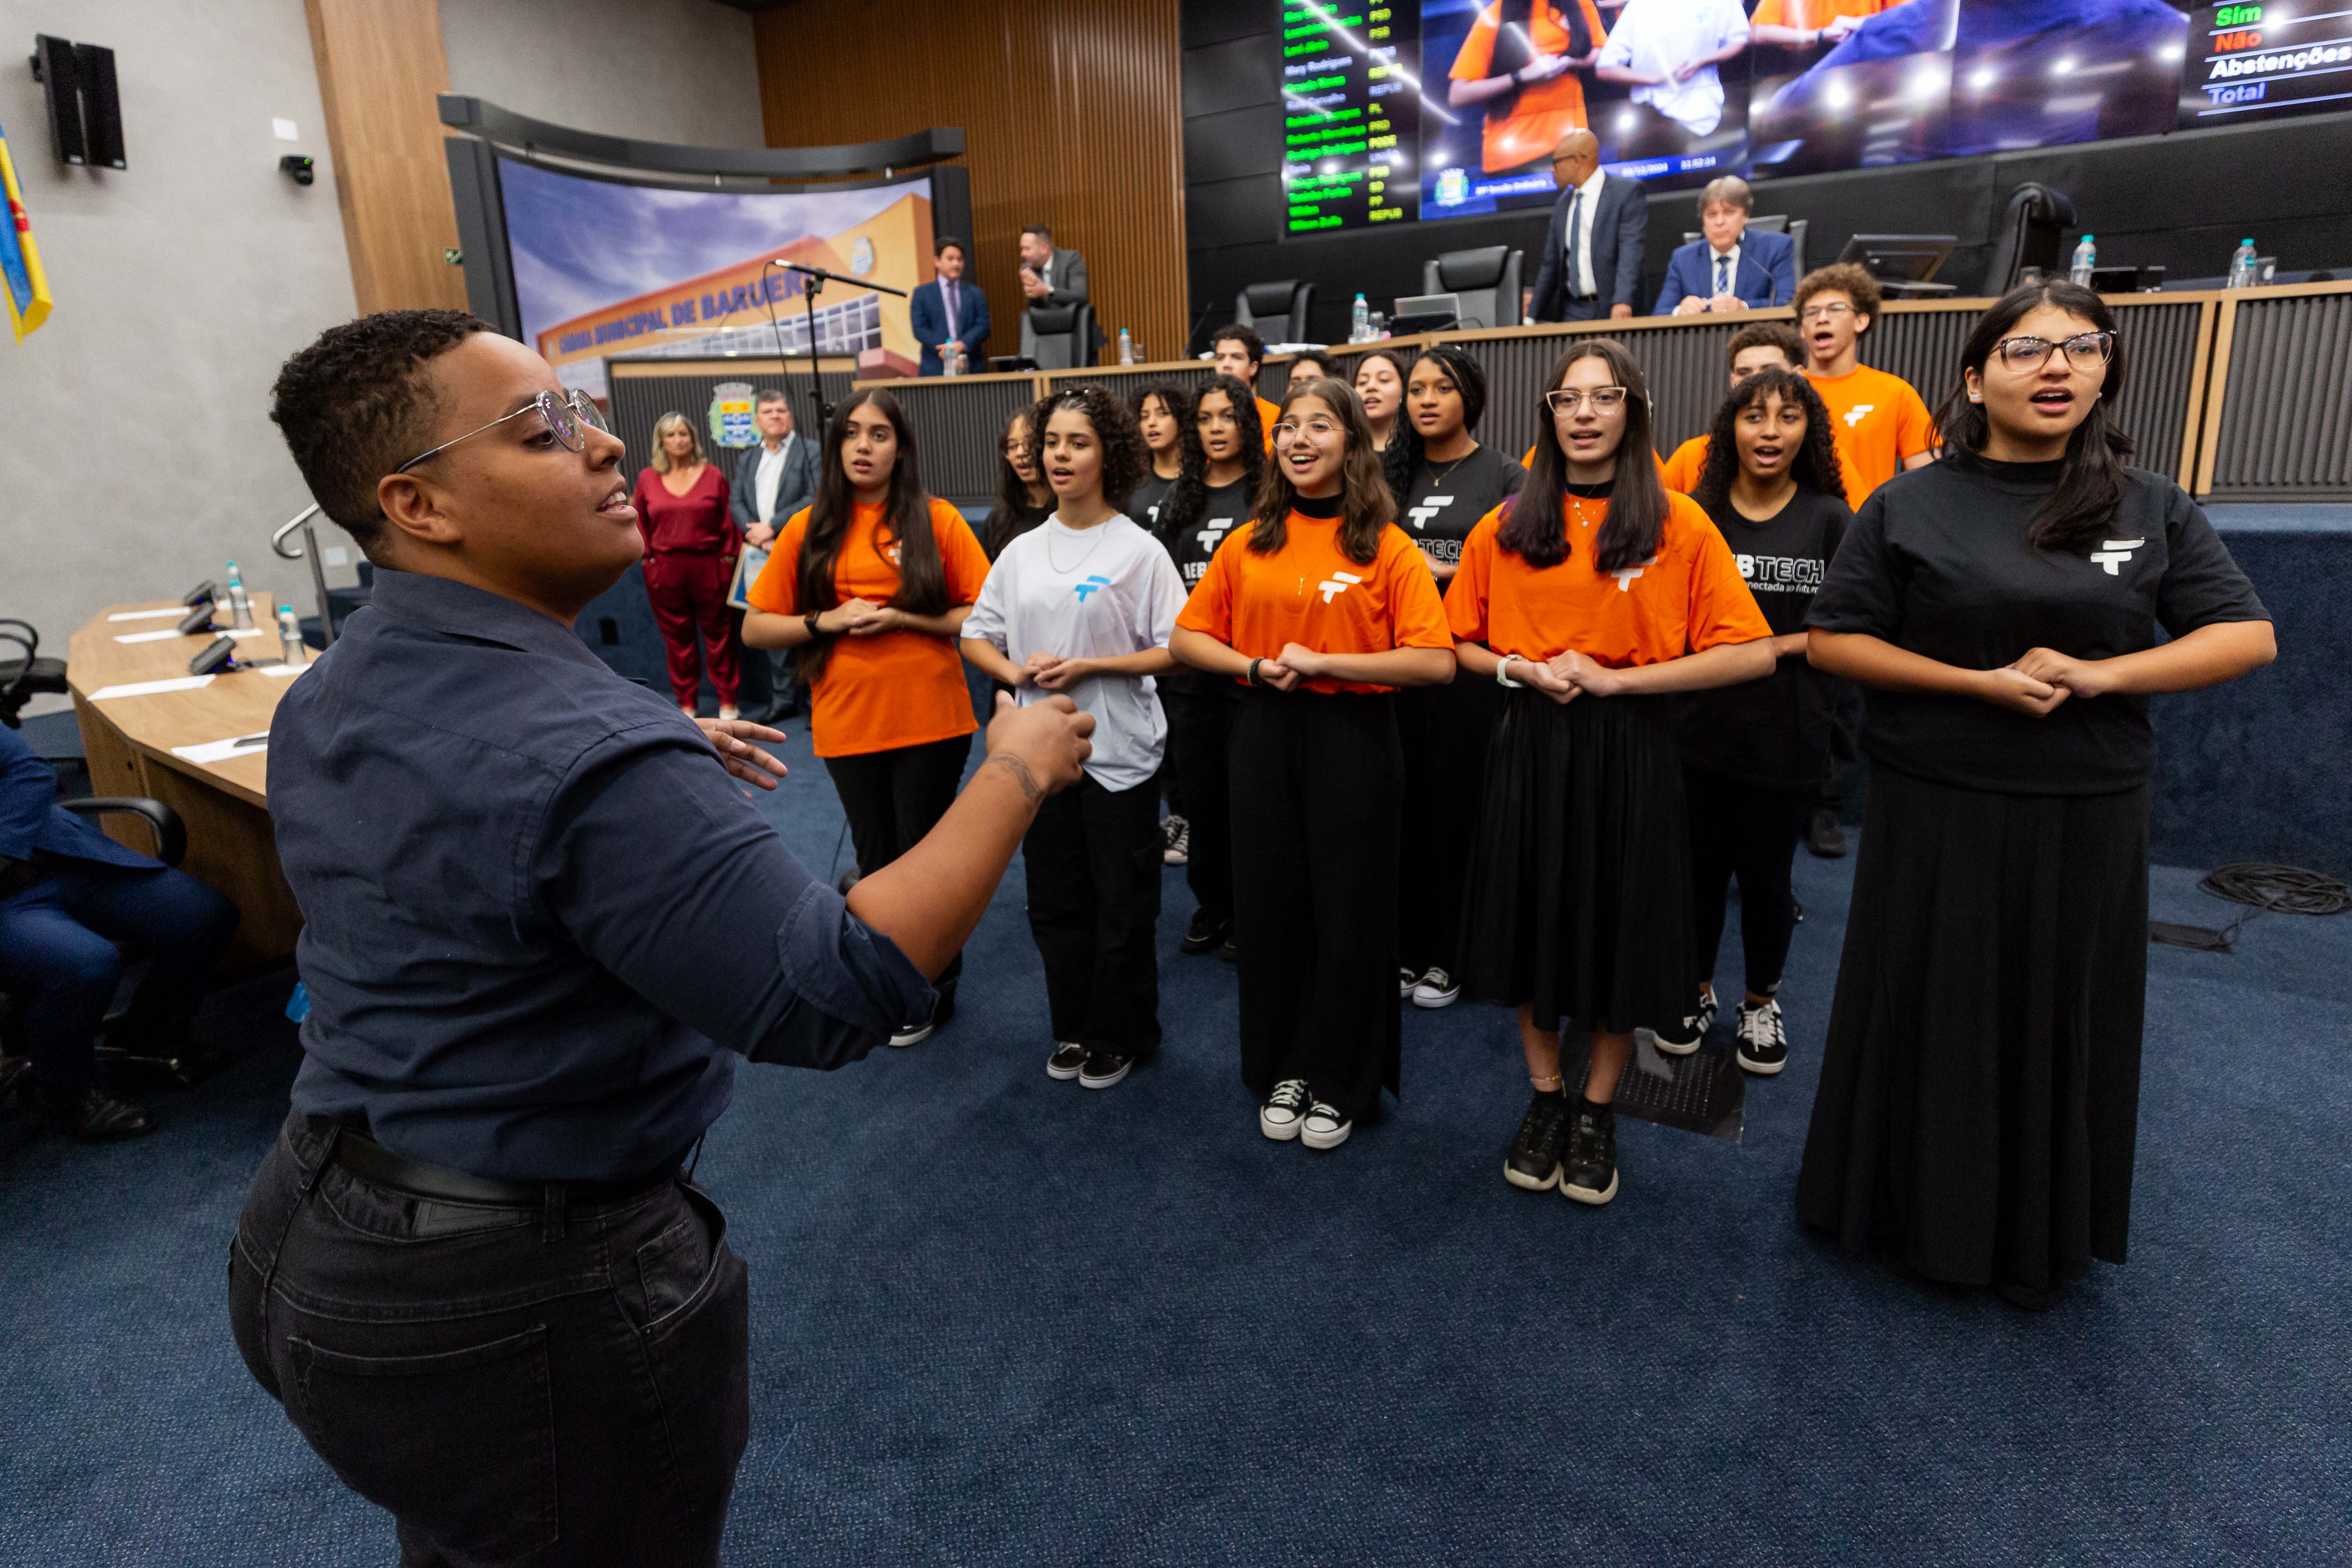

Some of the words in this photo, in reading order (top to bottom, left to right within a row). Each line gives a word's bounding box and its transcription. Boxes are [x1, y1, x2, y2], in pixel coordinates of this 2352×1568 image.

[2216, 6, 2262, 27] Sim
[2215, 31, 2262, 52] Não
[2209, 46, 2352, 79] Abstenções
[1369, 81, 1403, 97] REPUB
[2208, 81, 2266, 106] Total
[1369, 134, 1397, 149] PODE
[1369, 207, 1403, 222] REPUB
[670, 300, 697, 327] DE
[1732, 554, 1824, 584] BTECH
[1746, 581, 1785, 592] nectada
